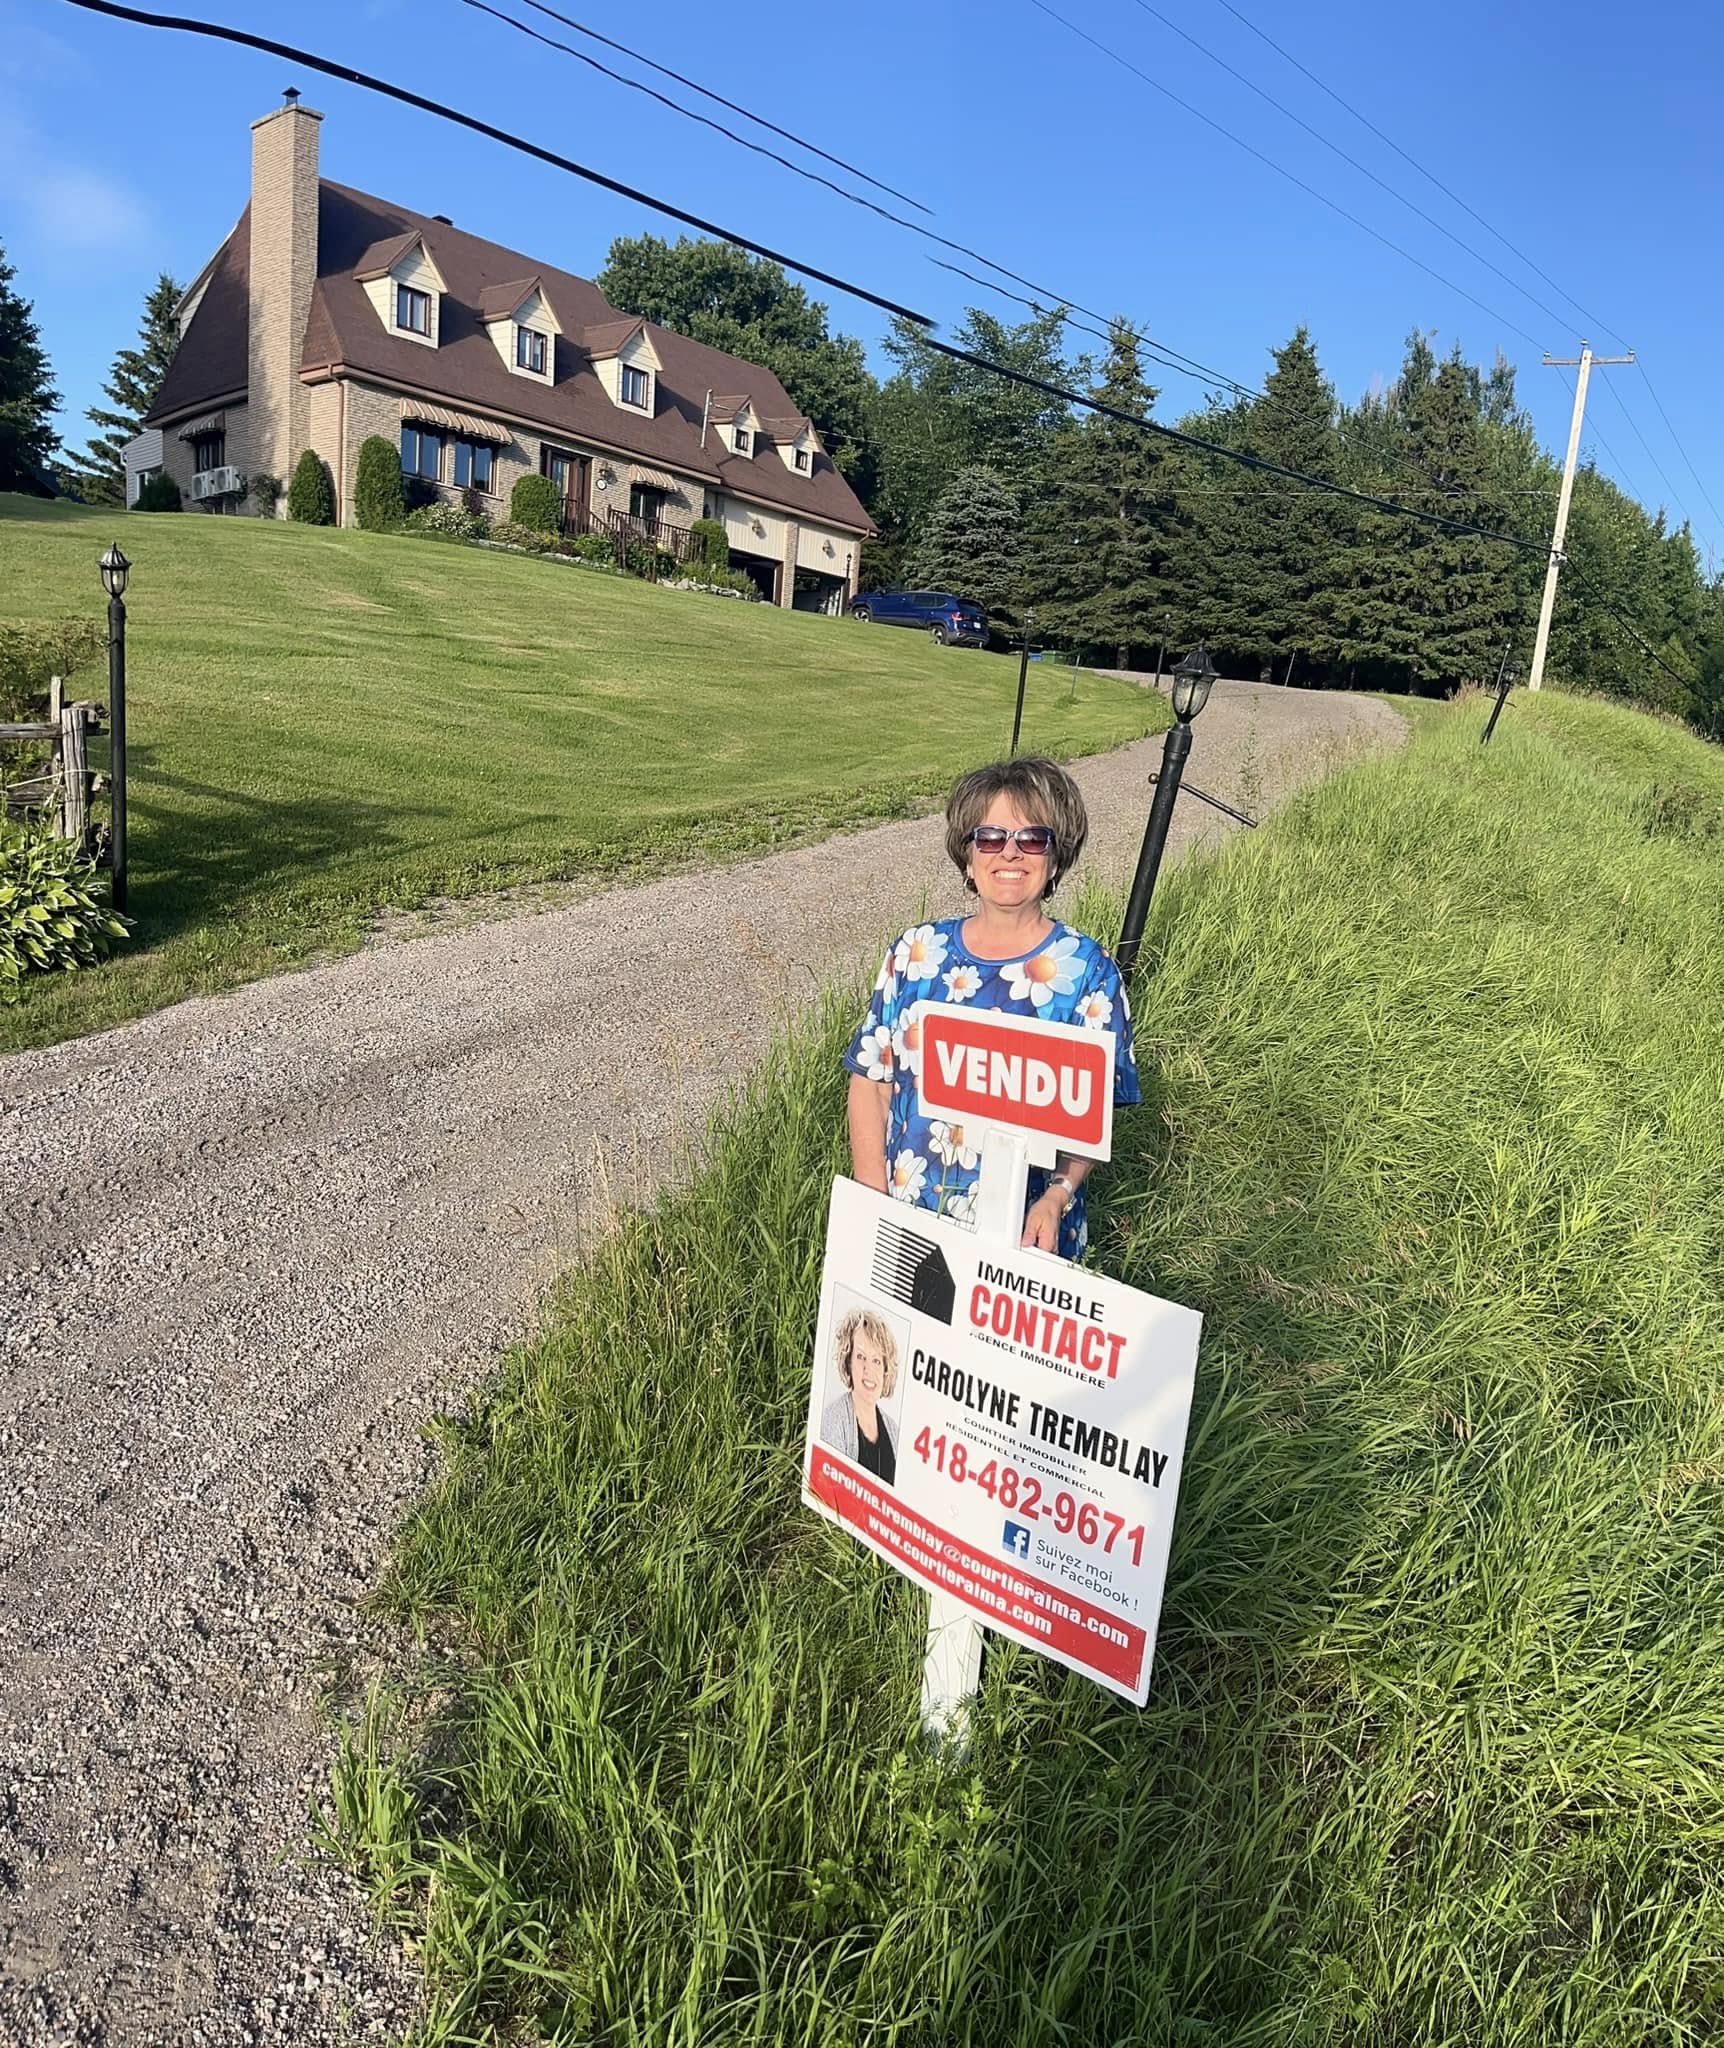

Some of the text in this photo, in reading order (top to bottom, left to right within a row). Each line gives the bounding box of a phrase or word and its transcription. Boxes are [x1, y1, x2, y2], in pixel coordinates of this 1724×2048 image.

[935, 1040, 1092, 1117] VENDU
[976, 1260, 1105, 1323] IMMEUBLE
[969, 1284, 1127, 1379] CONTACT
[911, 1349, 1169, 1489] CAROLYNE TREMBLAY
[964, 1417, 1087, 1476] COURTIER IMMOBILIER
[913, 1426, 1146, 1567] 418-482-9671
[1013, 1453, 1027, 1464] ET
[1030, 1461, 1106, 1499] COMMERCIAL
[822, 1462, 1129, 1649] carolyne.tremblay@courtieralma.com
[868, 1514, 1052, 1635] www.courtieralma.com
[1035, 1555, 1056, 1571] sur
[1060, 1566, 1129, 1607] Facebook
[1036, 1539, 1113, 1583] Suivez moi
